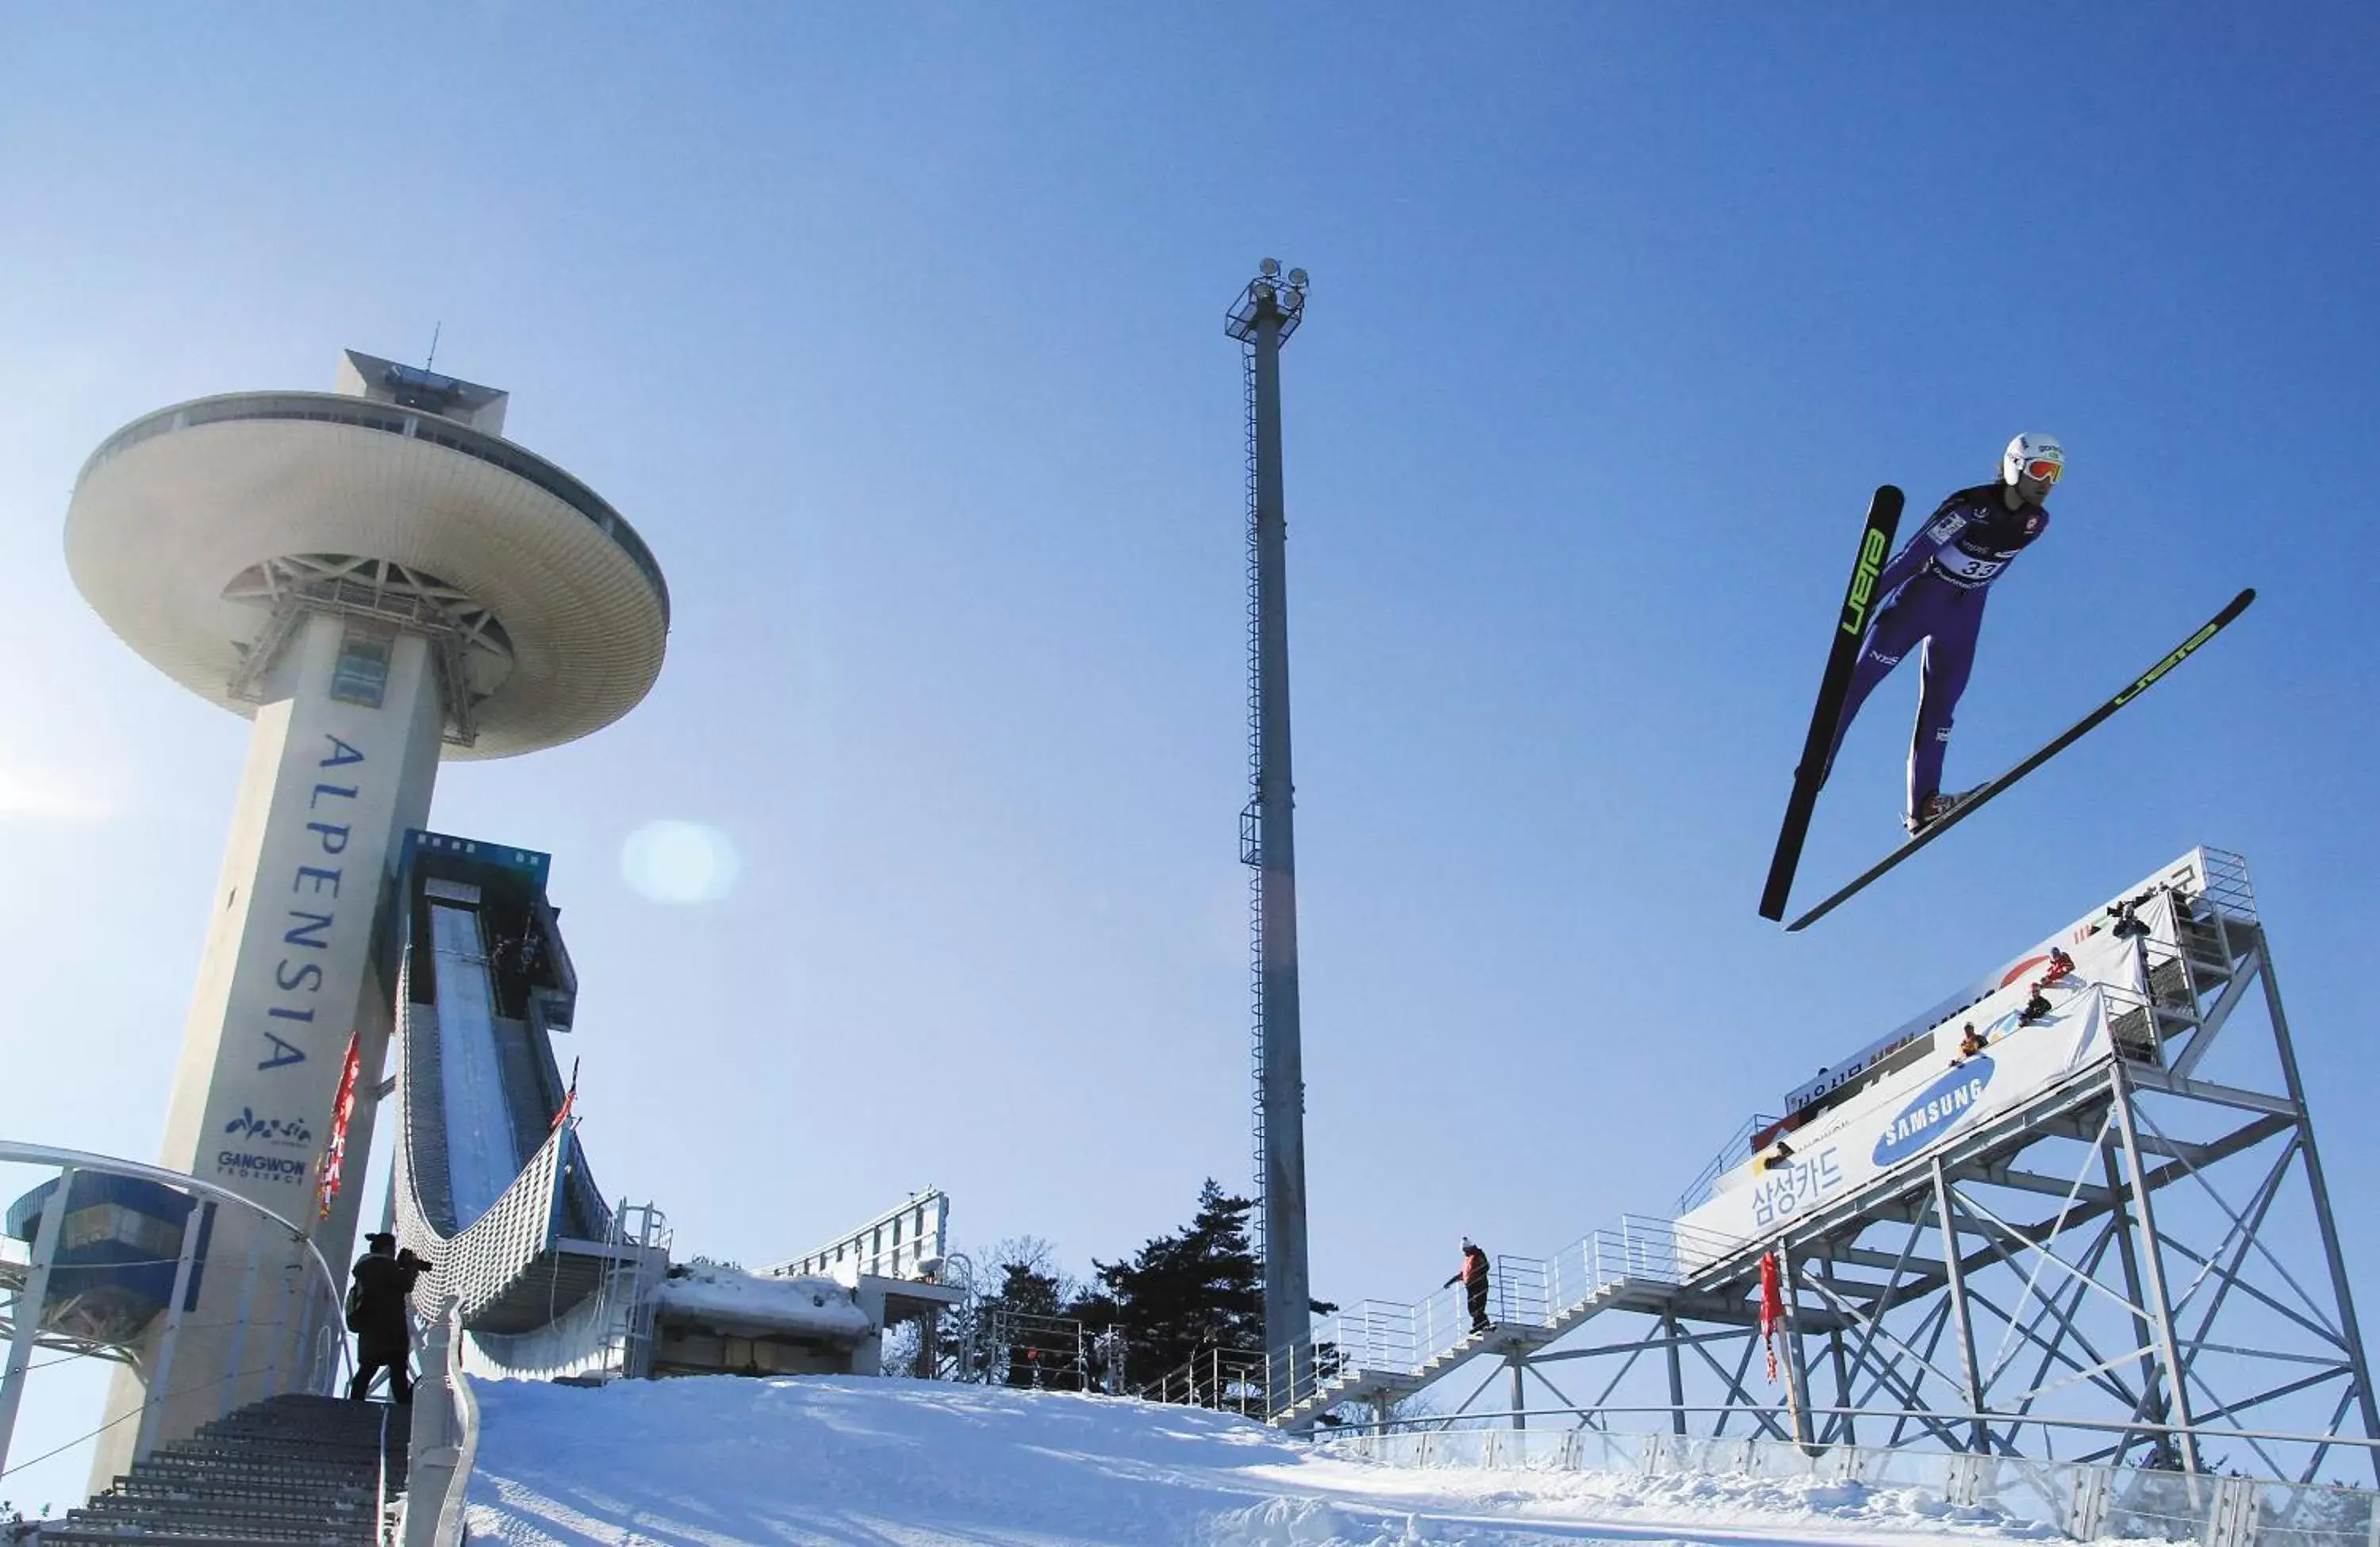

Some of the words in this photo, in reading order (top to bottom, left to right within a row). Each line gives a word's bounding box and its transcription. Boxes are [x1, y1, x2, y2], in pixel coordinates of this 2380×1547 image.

[1962, 561, 1997, 576] 33
[258, 734, 364, 1070] ALPENSIA
[1885, 1079, 1981, 1146] SAMSUNG
[218, 1151, 306, 1176] GANGWON
[1752, 1147, 1842, 1226] 삼성카드
